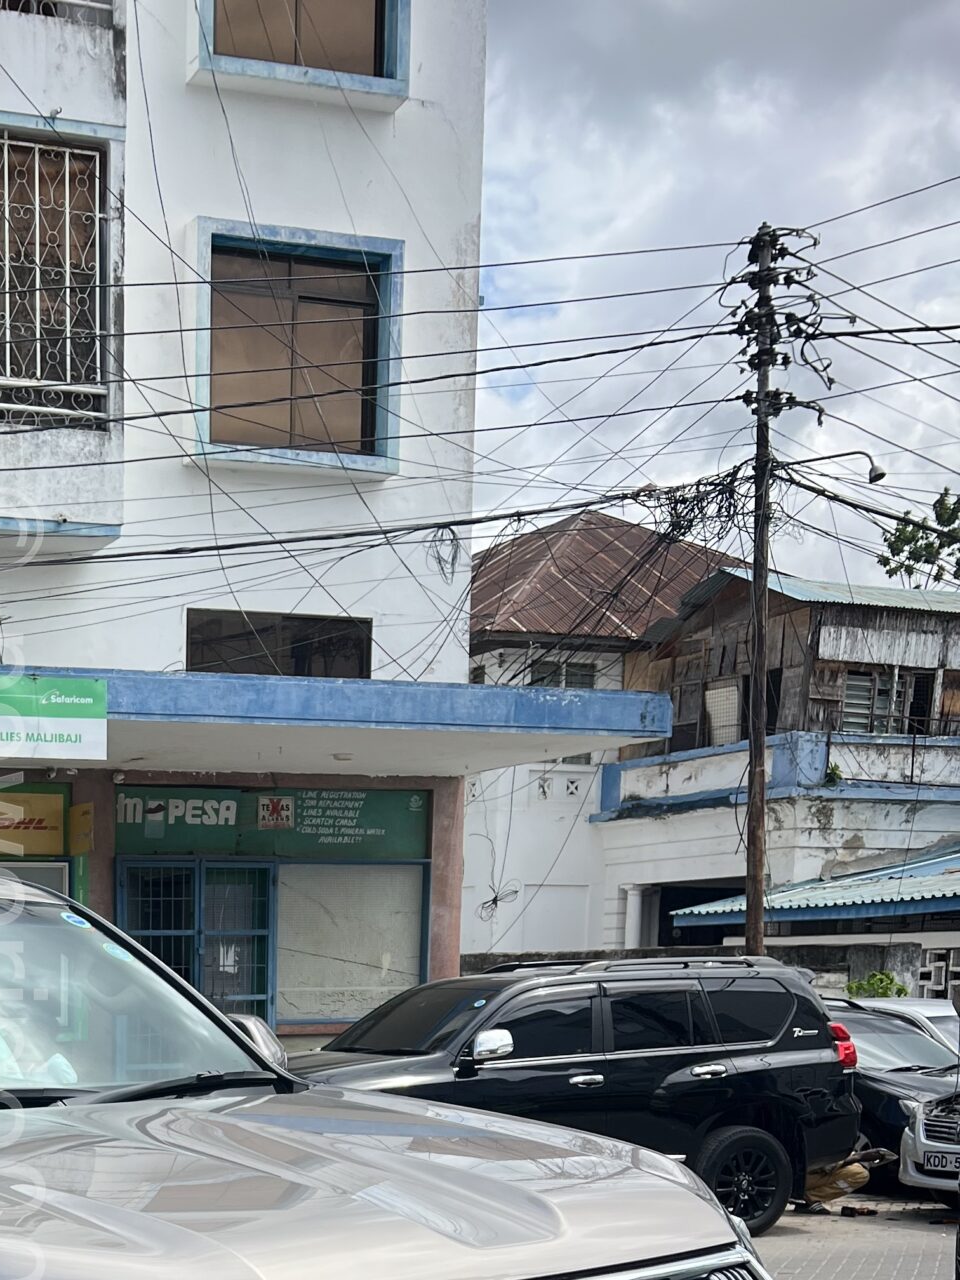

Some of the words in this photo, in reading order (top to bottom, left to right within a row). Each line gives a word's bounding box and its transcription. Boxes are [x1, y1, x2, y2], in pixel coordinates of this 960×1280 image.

[50, 694, 93, 704] Safaricom
[302, 791, 318, 799] LINE
[320, 791, 367, 799] REGISTRATION
[261, 798, 290, 816] TEXAS
[318, 800, 364, 808] REPLACEMENT
[325, 809, 360, 817] AVAILABLE
[303, 817, 334, 825] SCRATCH
[335, 818, 357, 826] CARDS
